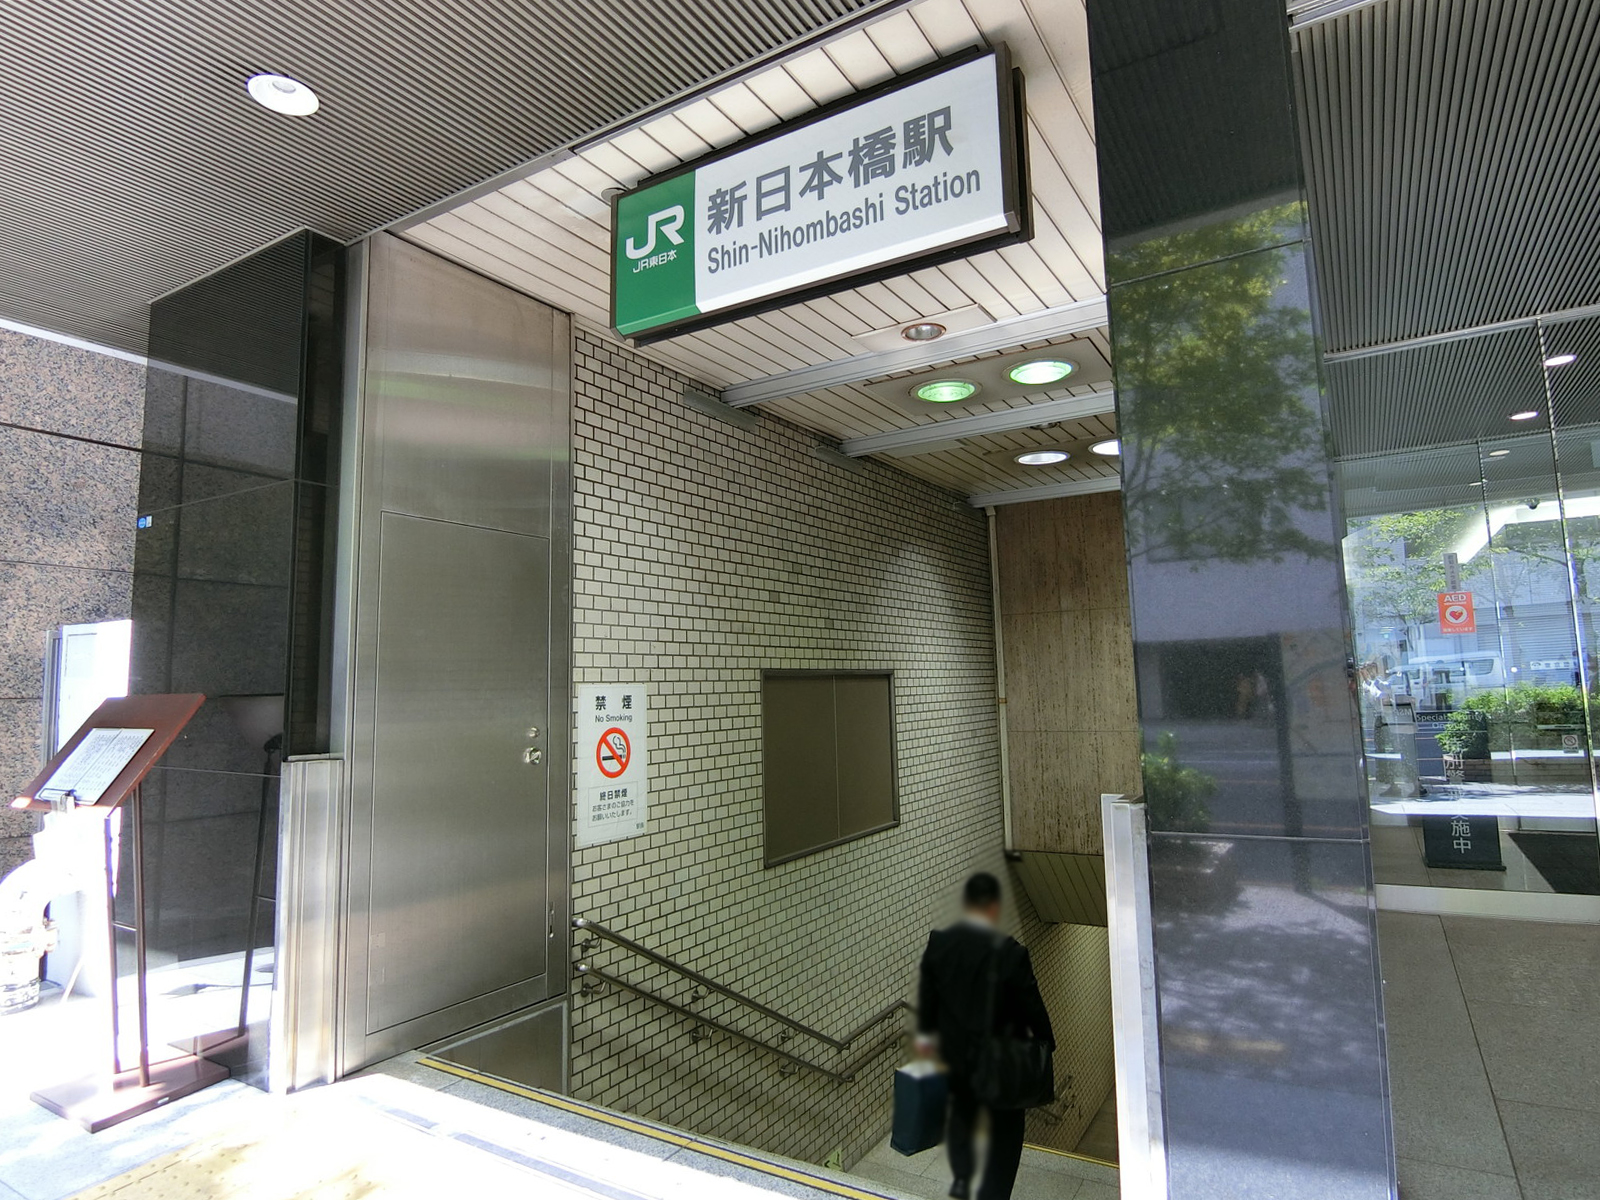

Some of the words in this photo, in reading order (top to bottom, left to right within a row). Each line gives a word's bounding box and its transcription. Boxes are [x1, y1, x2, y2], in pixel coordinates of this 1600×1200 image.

[707, 106, 954, 235] 新日本橋駅
[625, 204, 685, 260] JR
[707, 192, 884, 275] Shin-Nihombashi
[894, 169, 981, 214] Station
[632, 249, 677, 273] JR東日本
[1444, 594, 1466, 602] AED
[595, 695, 633, 711] 禁煙
[595, 715, 604, 723] No
[605, 714, 633, 723] Smoking
[599, 788, 628, 802] 終日禁煙
